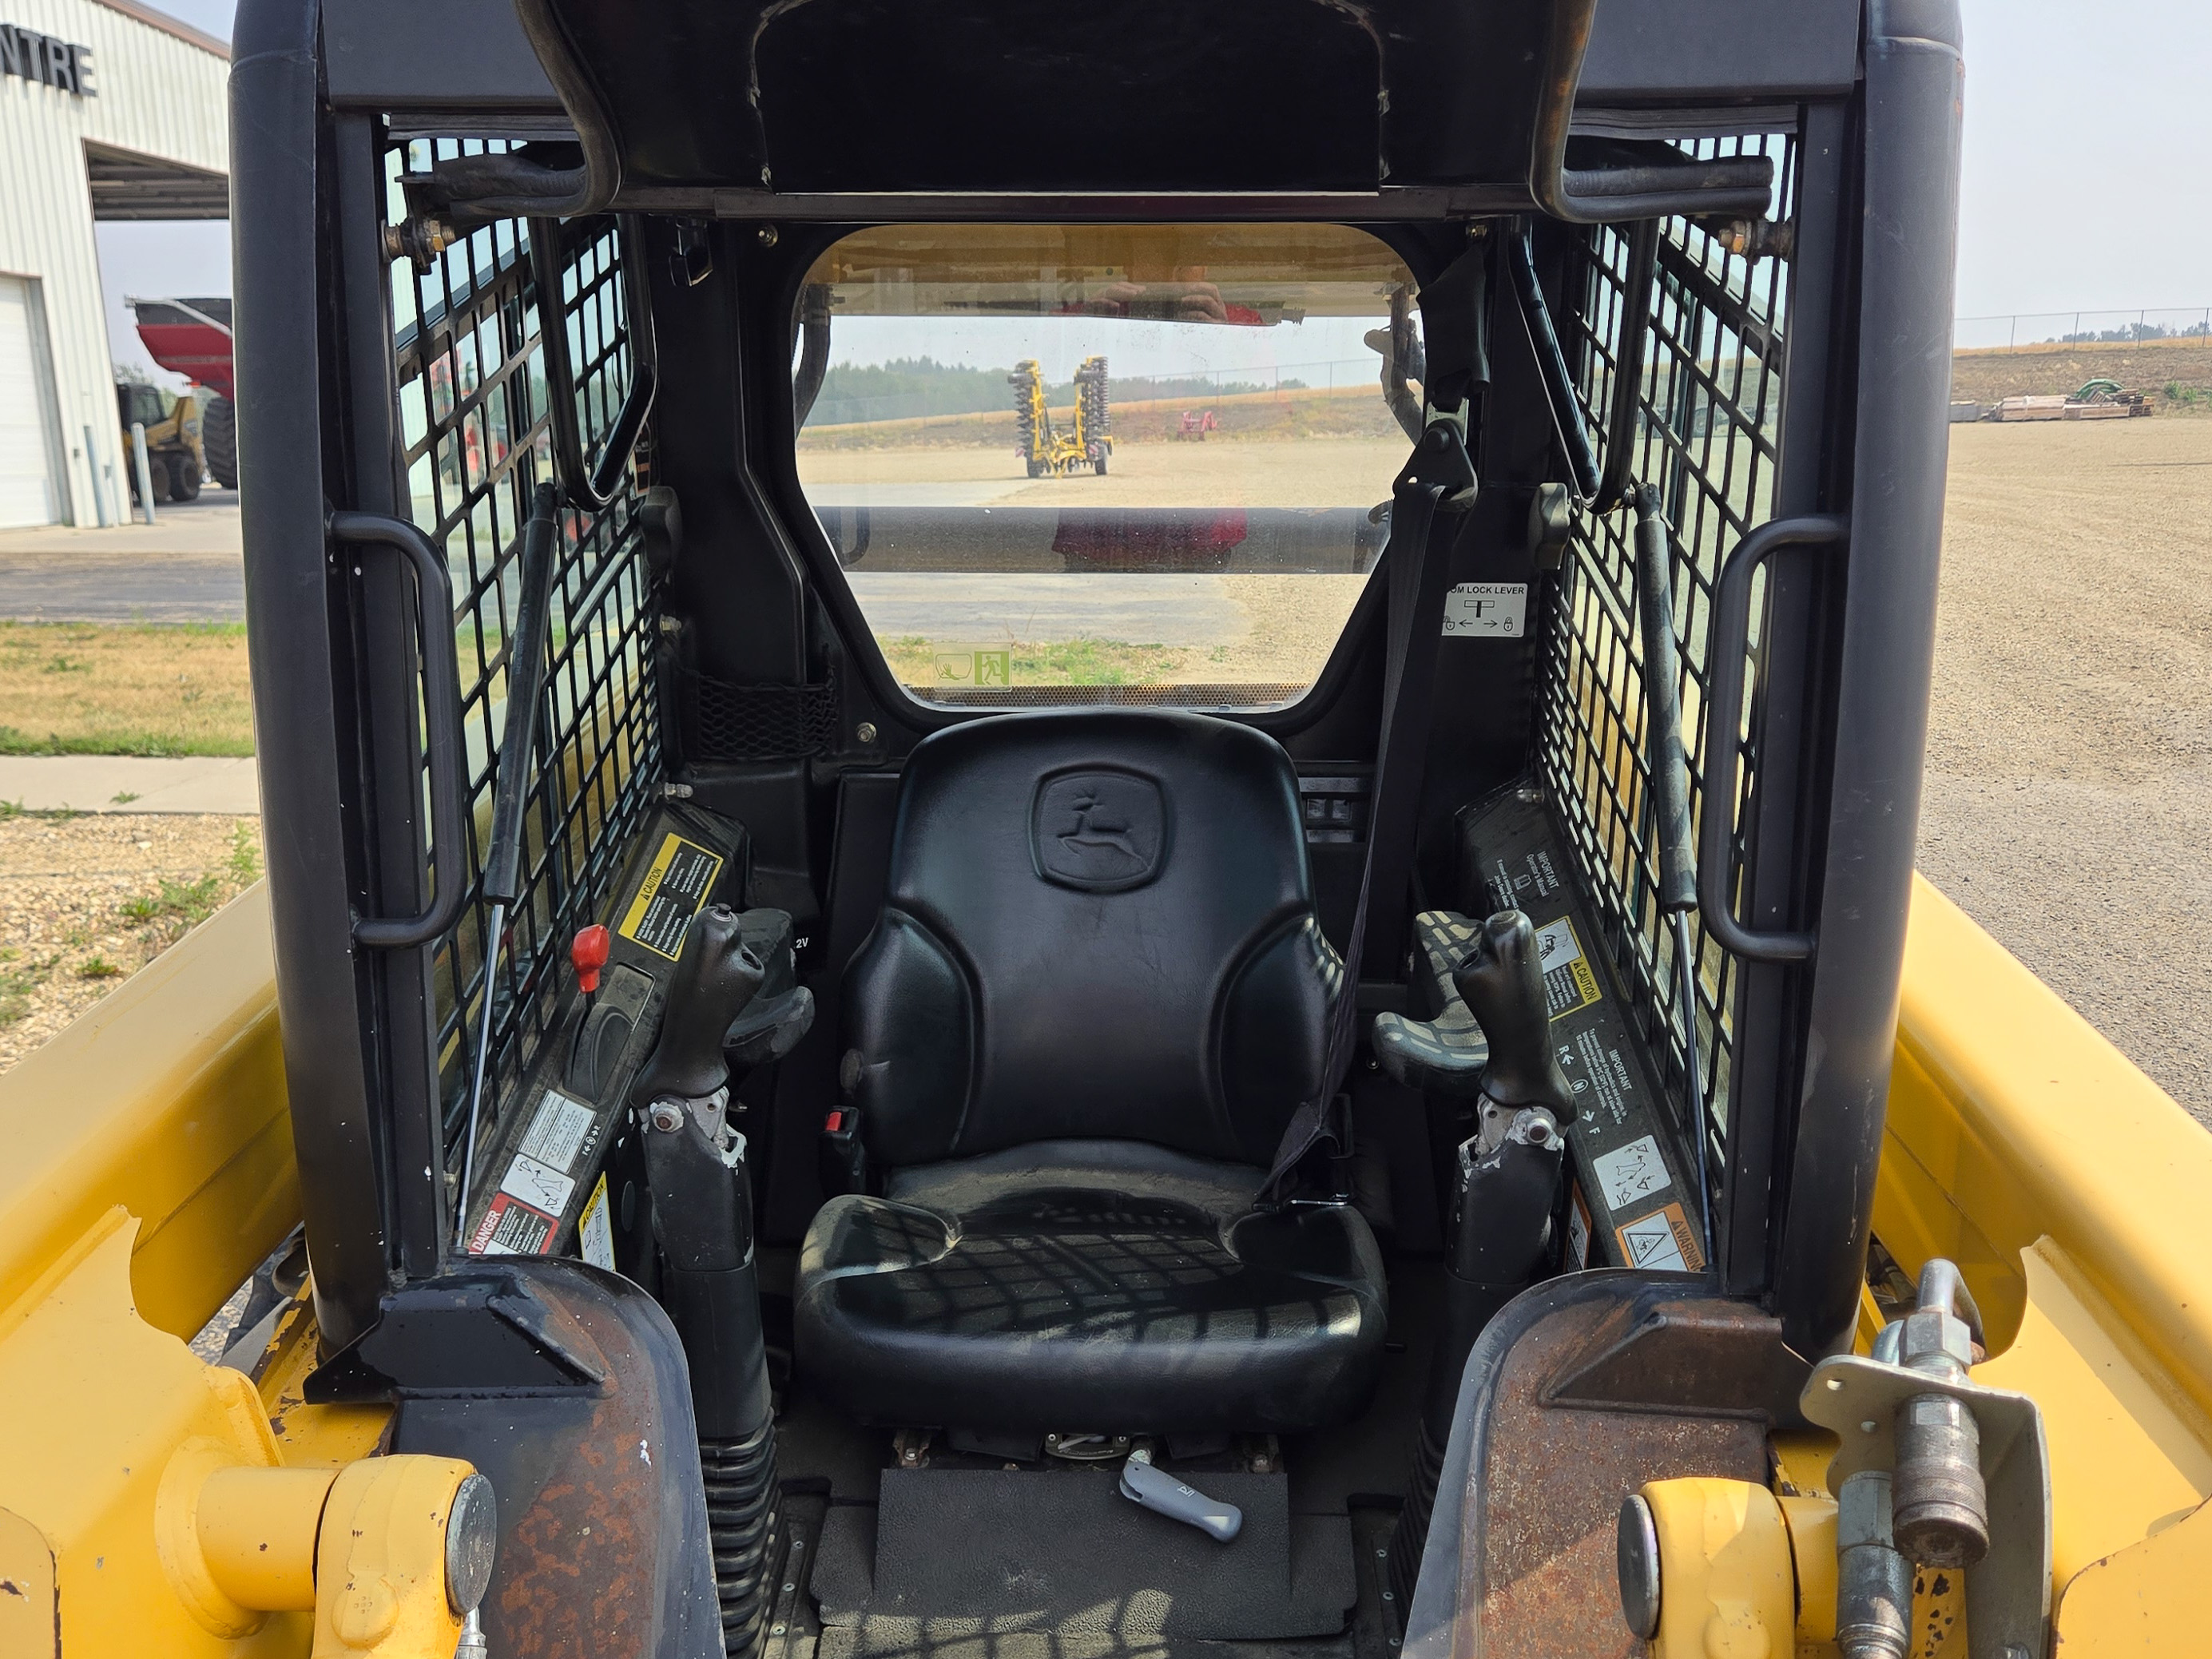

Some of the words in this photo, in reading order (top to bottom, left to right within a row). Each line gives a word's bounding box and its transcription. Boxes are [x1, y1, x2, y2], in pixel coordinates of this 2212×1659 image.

[642, 865, 663, 895] CAUTION
[1523, 852, 1542, 879] Operator's
[1535, 876, 1549, 897] Manual
[1536, 850, 1559, 890] IMPORTANT
[793, 937, 808, 949] 2V
[1575, 966, 1597, 1001] CAUTION
[1558, 1044, 1570, 1055] R
[1573, 1080, 1585, 1091] N
[1588, 1125, 1601, 1137] F
[1608, 1048, 1632, 1093] IMPORTANT
[471, 1208, 502, 1252] DANGER
